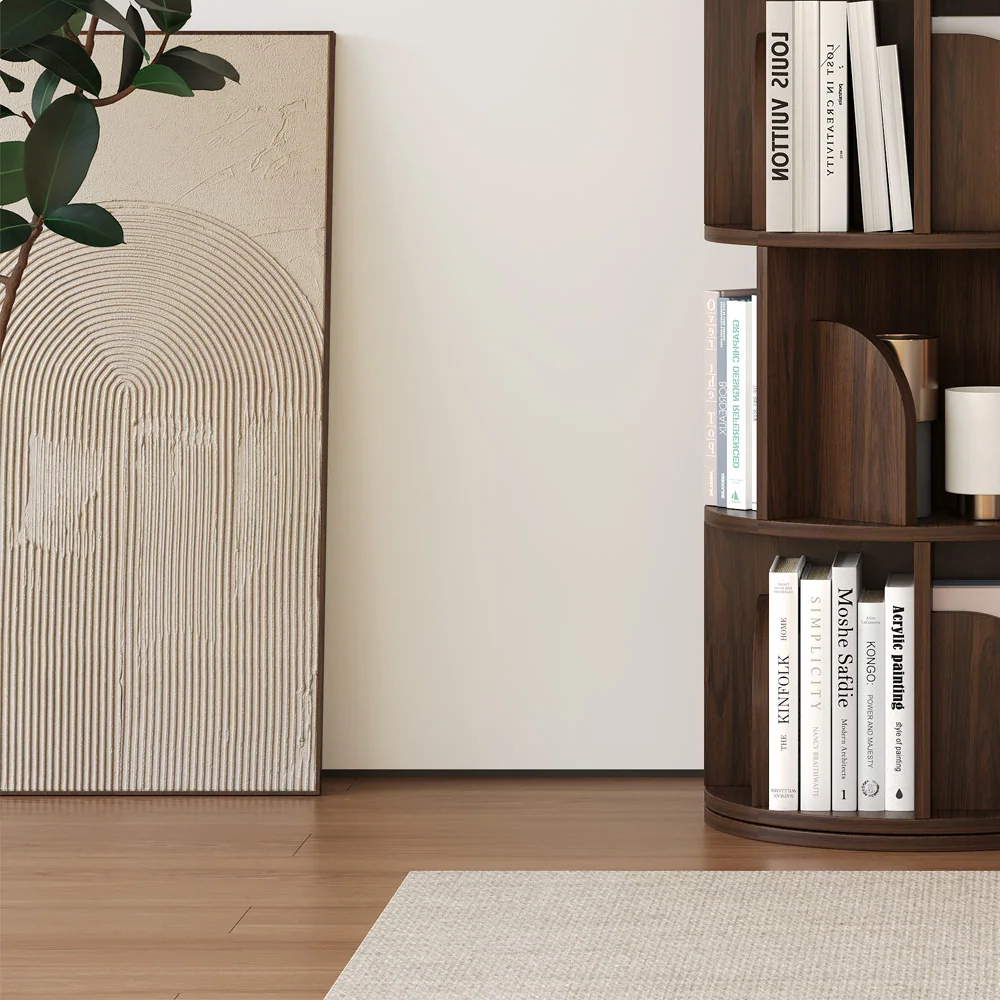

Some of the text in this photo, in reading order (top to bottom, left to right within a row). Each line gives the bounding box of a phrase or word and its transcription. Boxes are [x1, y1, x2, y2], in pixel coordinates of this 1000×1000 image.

[837, 588, 854, 648] Moshe
[891, 605, 905, 651] Acrylic
[810, 596, 822, 712] SIMPLICITY
[837, 653, 854, 708] Safdie
[866, 641, 876, 686] KONGO:
[777, 655, 790, 725] KINFOLK
[891, 654, 906, 711] painting
[894, 721, 903, 737] style
[894, 746, 903, 772] painting
